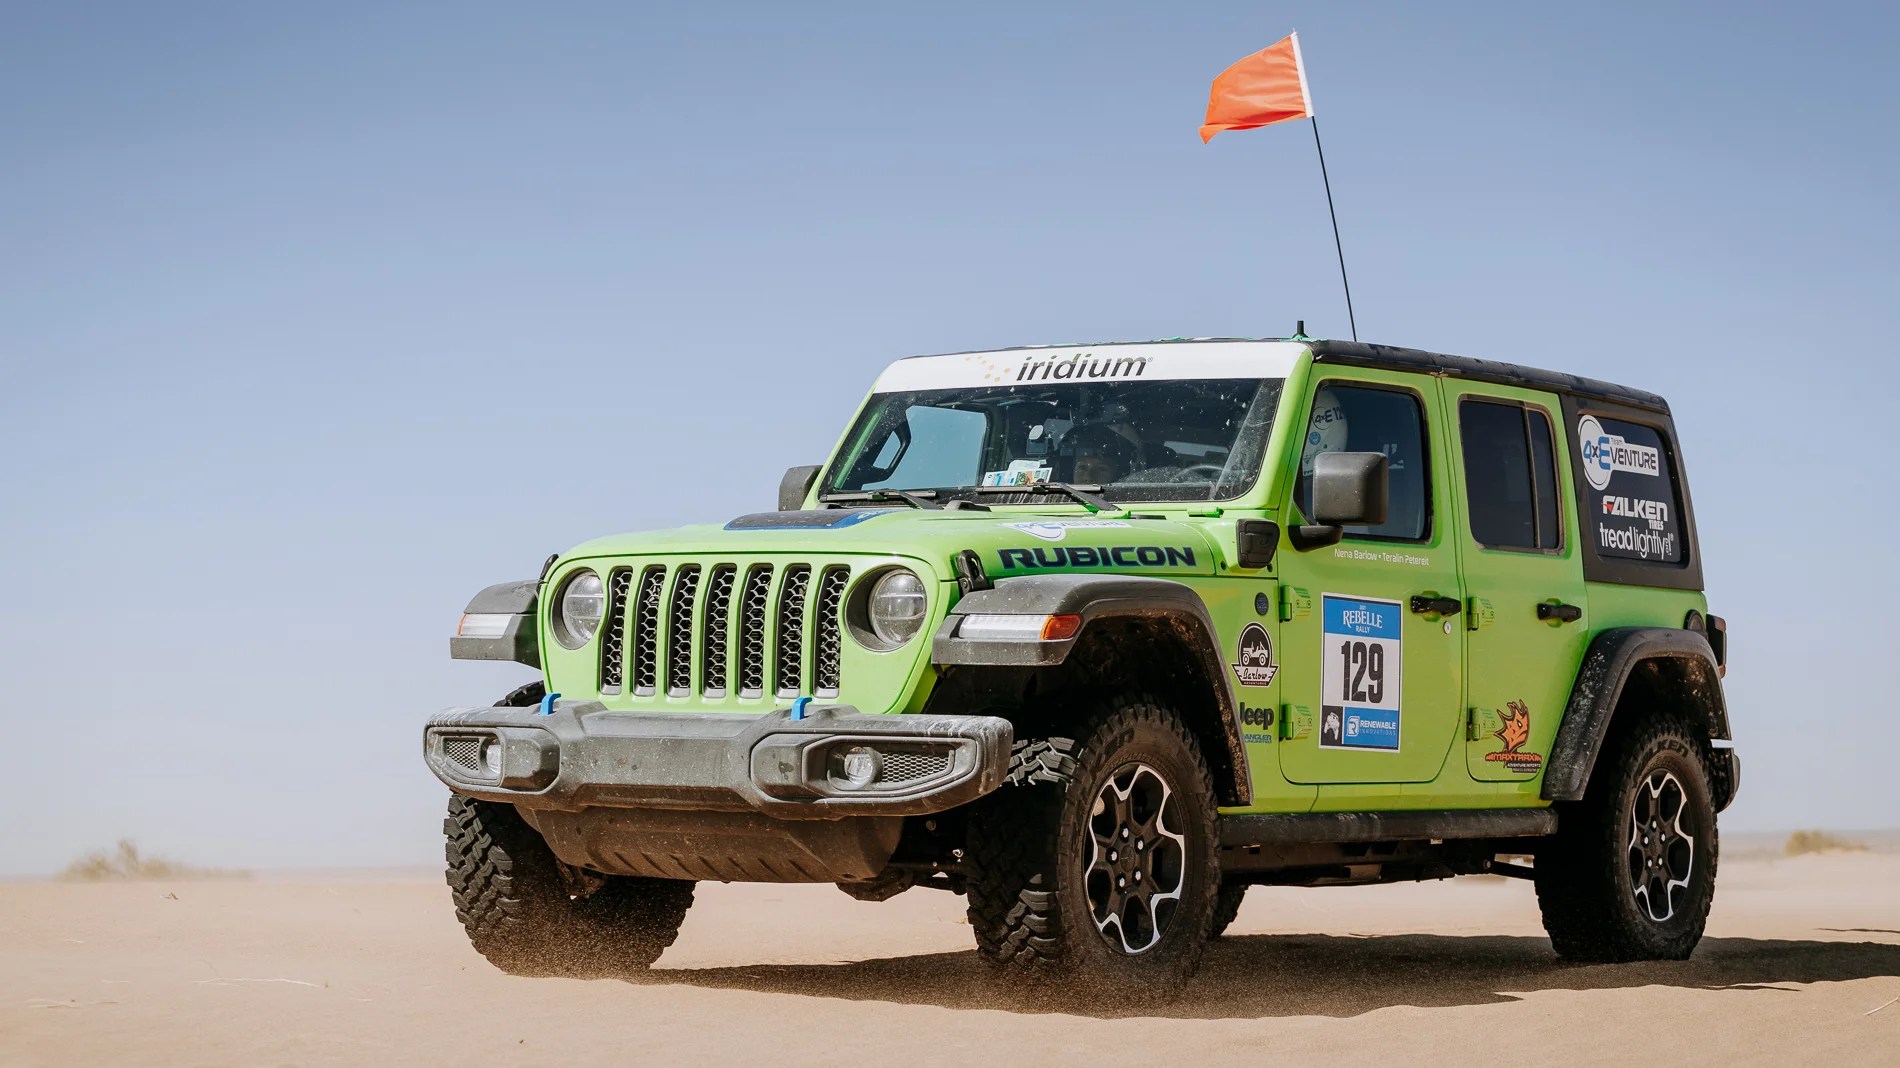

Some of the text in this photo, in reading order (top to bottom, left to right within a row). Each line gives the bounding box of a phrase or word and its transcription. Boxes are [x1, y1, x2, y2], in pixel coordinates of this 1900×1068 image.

[1610, 447, 1657, 471] VENTURE
[1601, 495, 1668, 522] FALKEN
[1649, 519, 1664, 531] TIRES
[997, 546, 1197, 570] RUBICON
[1334, 548, 1353, 559] Nena
[1354, 550, 1377, 561] Barlow
[1343, 610, 1383, 629] REBELLE
[1355, 625, 1371, 633] RALLY
[1243, 668, 1268, 680] Barlow
[1341, 640, 1384, 704] 129
[1240, 701, 1274, 730] Jeep
[1360, 720, 1396, 730] RENEWABLE
[1493, 753, 1535, 761] MAXTRAX
